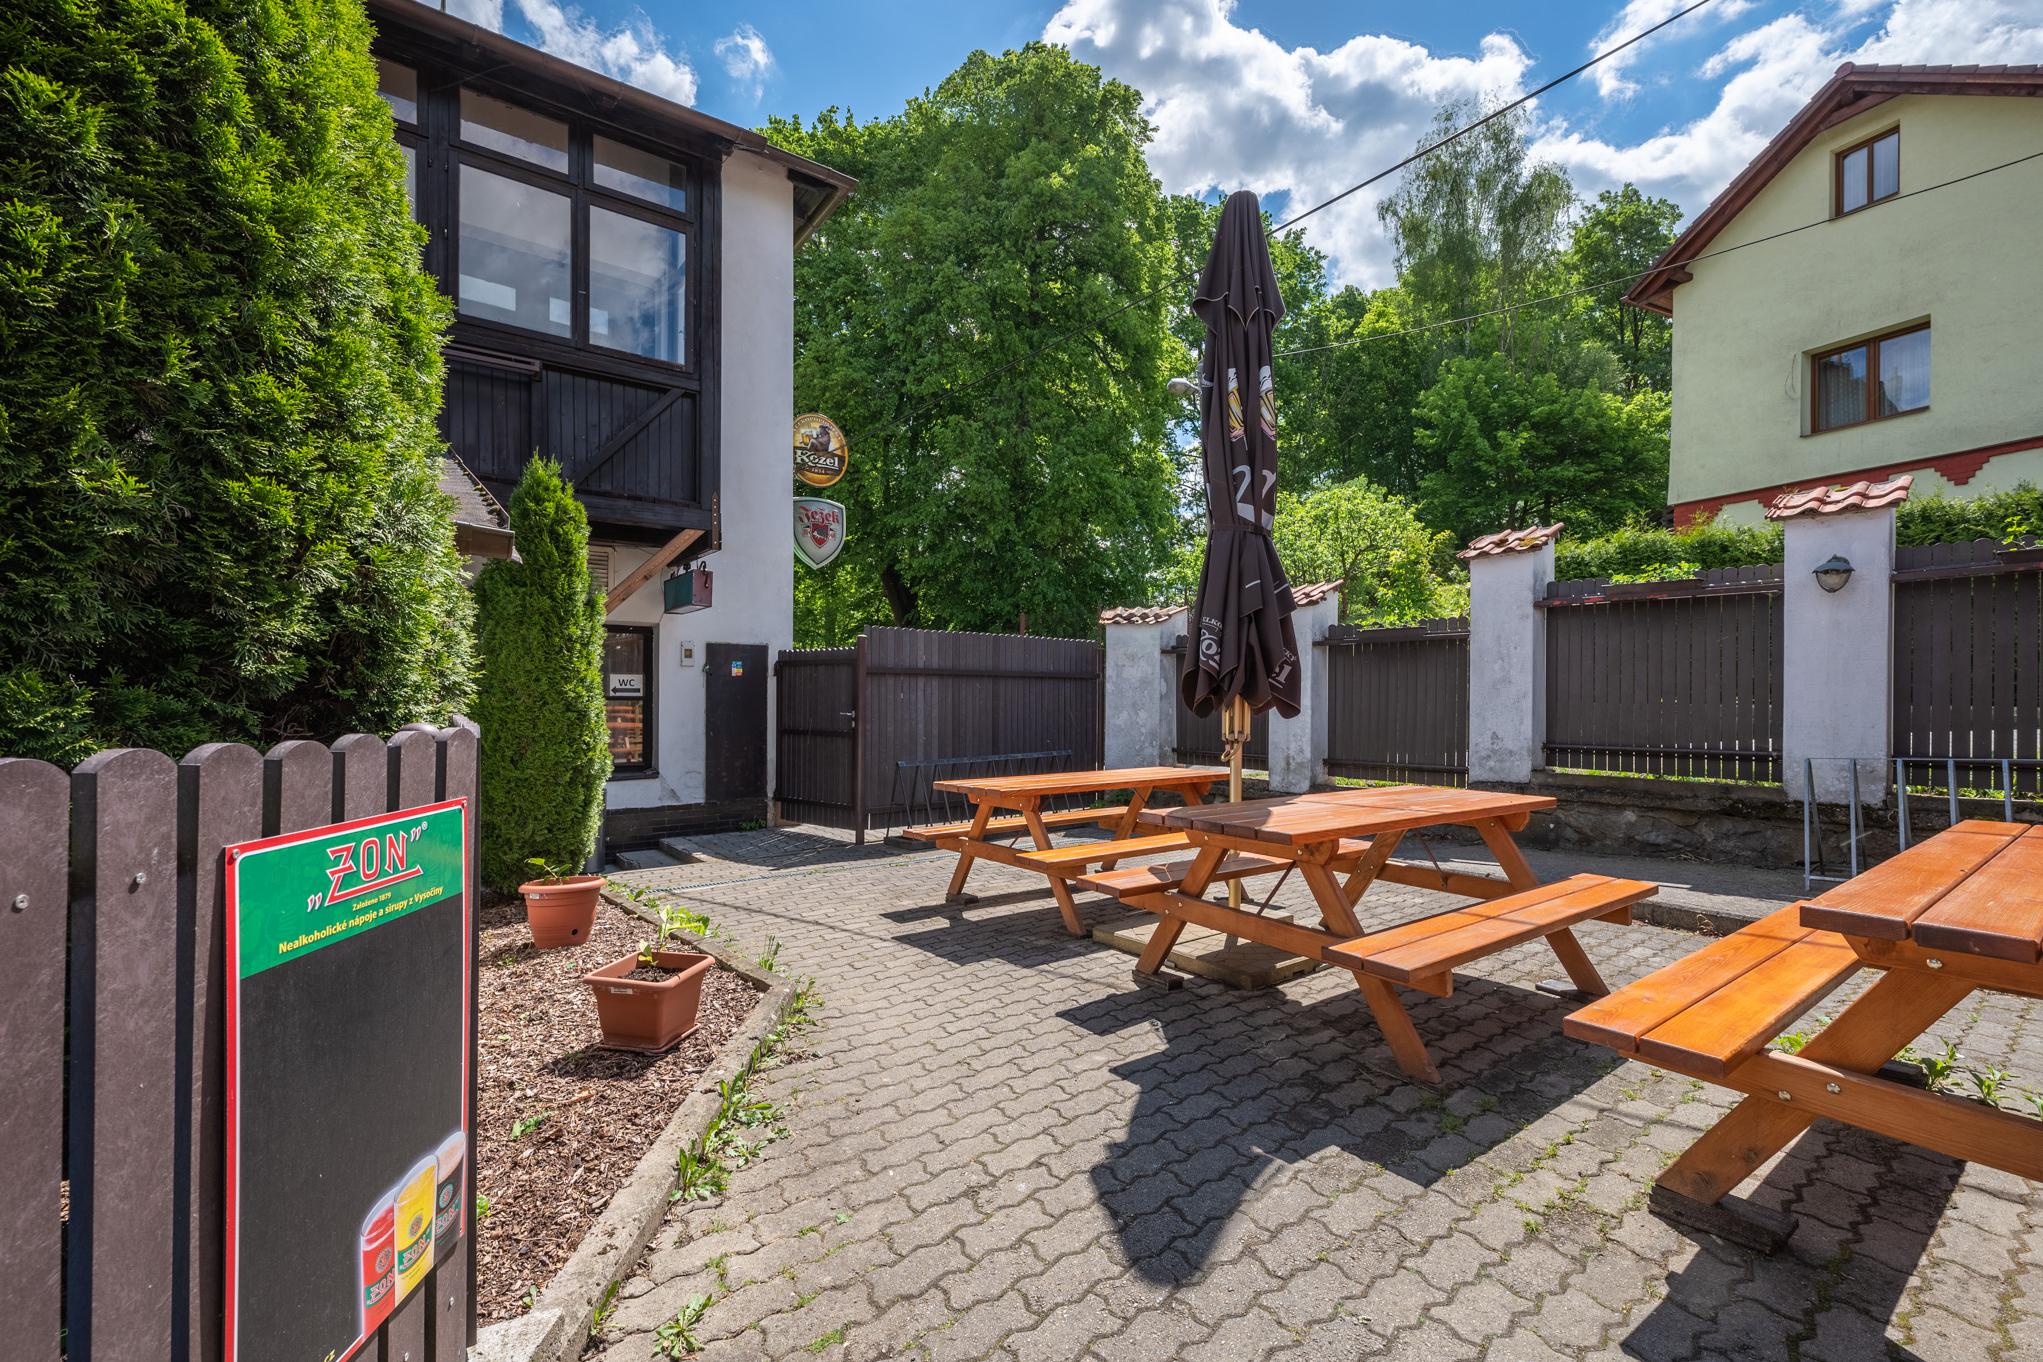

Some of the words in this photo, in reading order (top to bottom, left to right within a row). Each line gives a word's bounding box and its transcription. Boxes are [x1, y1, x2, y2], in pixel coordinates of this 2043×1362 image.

[795, 449, 839, 469] Kozel
[799, 506, 839, 524] Ježek
[618, 679, 635, 687] WC
[279, 920, 347, 954] Nealkoholické
[348, 910, 378, 928] nápoje
[378, 908, 384, 917] a
[385, 899, 408, 914] sirupy
[408, 897, 414, 905] z
[414, 886, 444, 903] Vysočiny
